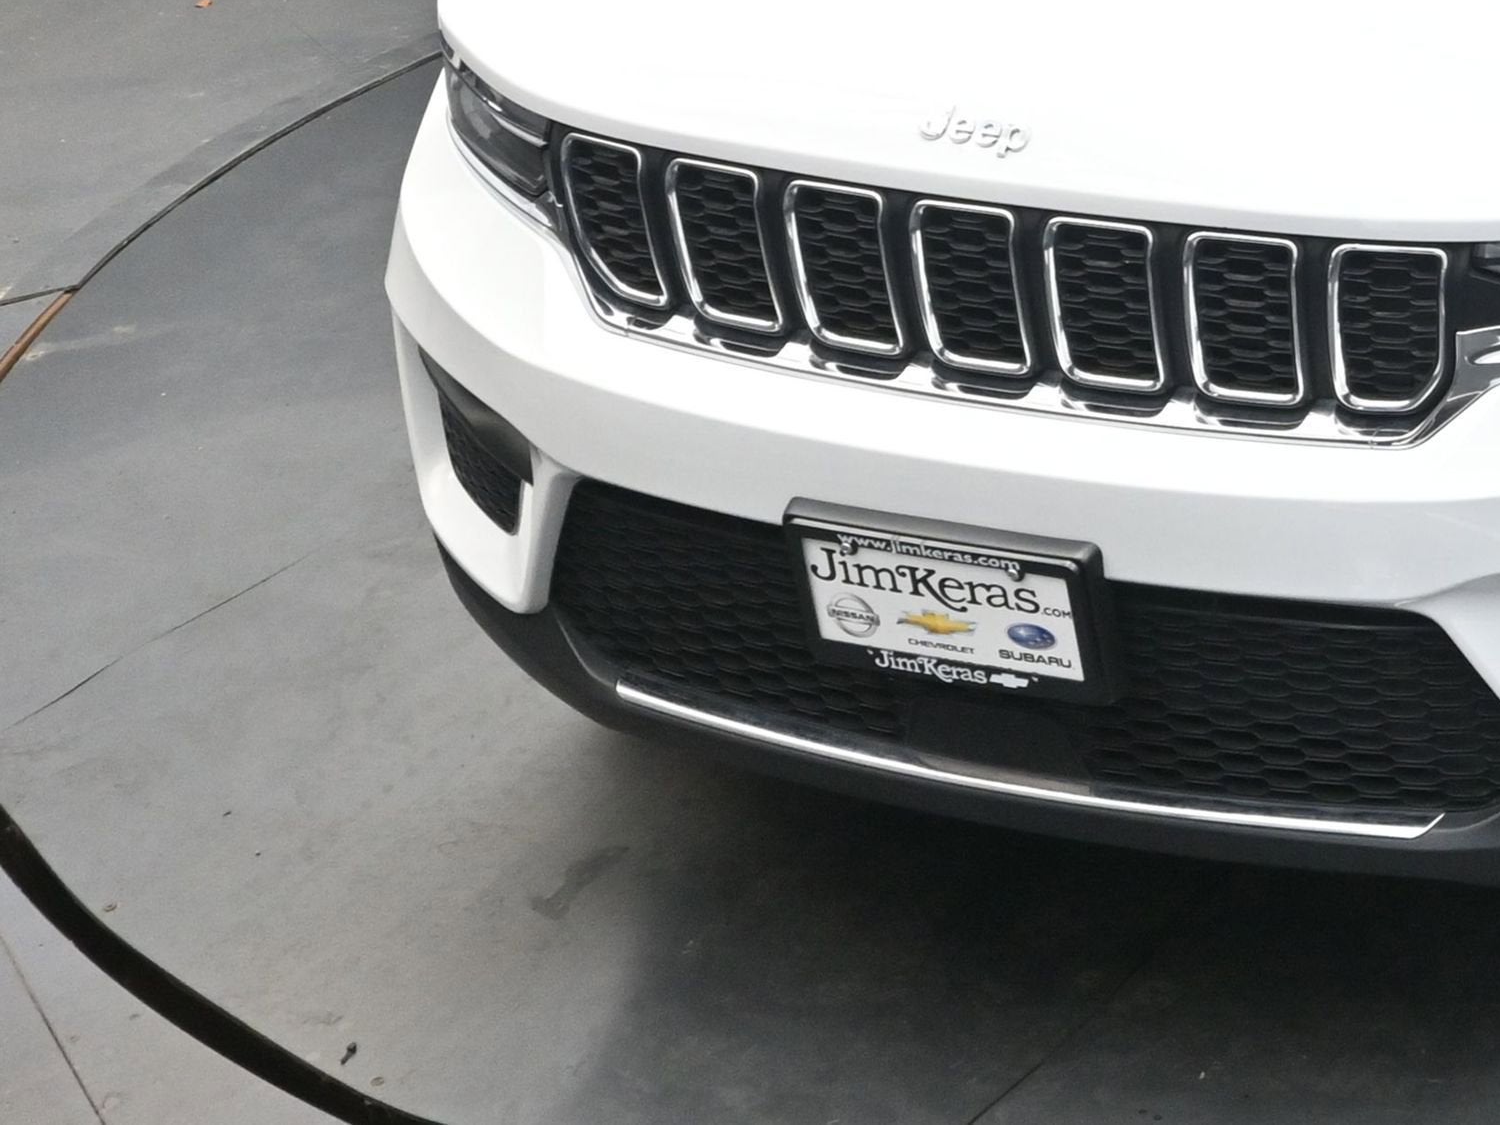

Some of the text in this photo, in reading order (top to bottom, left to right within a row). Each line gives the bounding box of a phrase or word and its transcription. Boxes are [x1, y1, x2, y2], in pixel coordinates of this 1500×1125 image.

[917, 104, 1031, 159] Jeep
[837, 533, 1021, 571] www.jimkeras.com
[830, 608, 876, 623] NISSAN
[907, 637, 975, 655] CHEVROLET
[998, 648, 1073, 669] SUBARU
